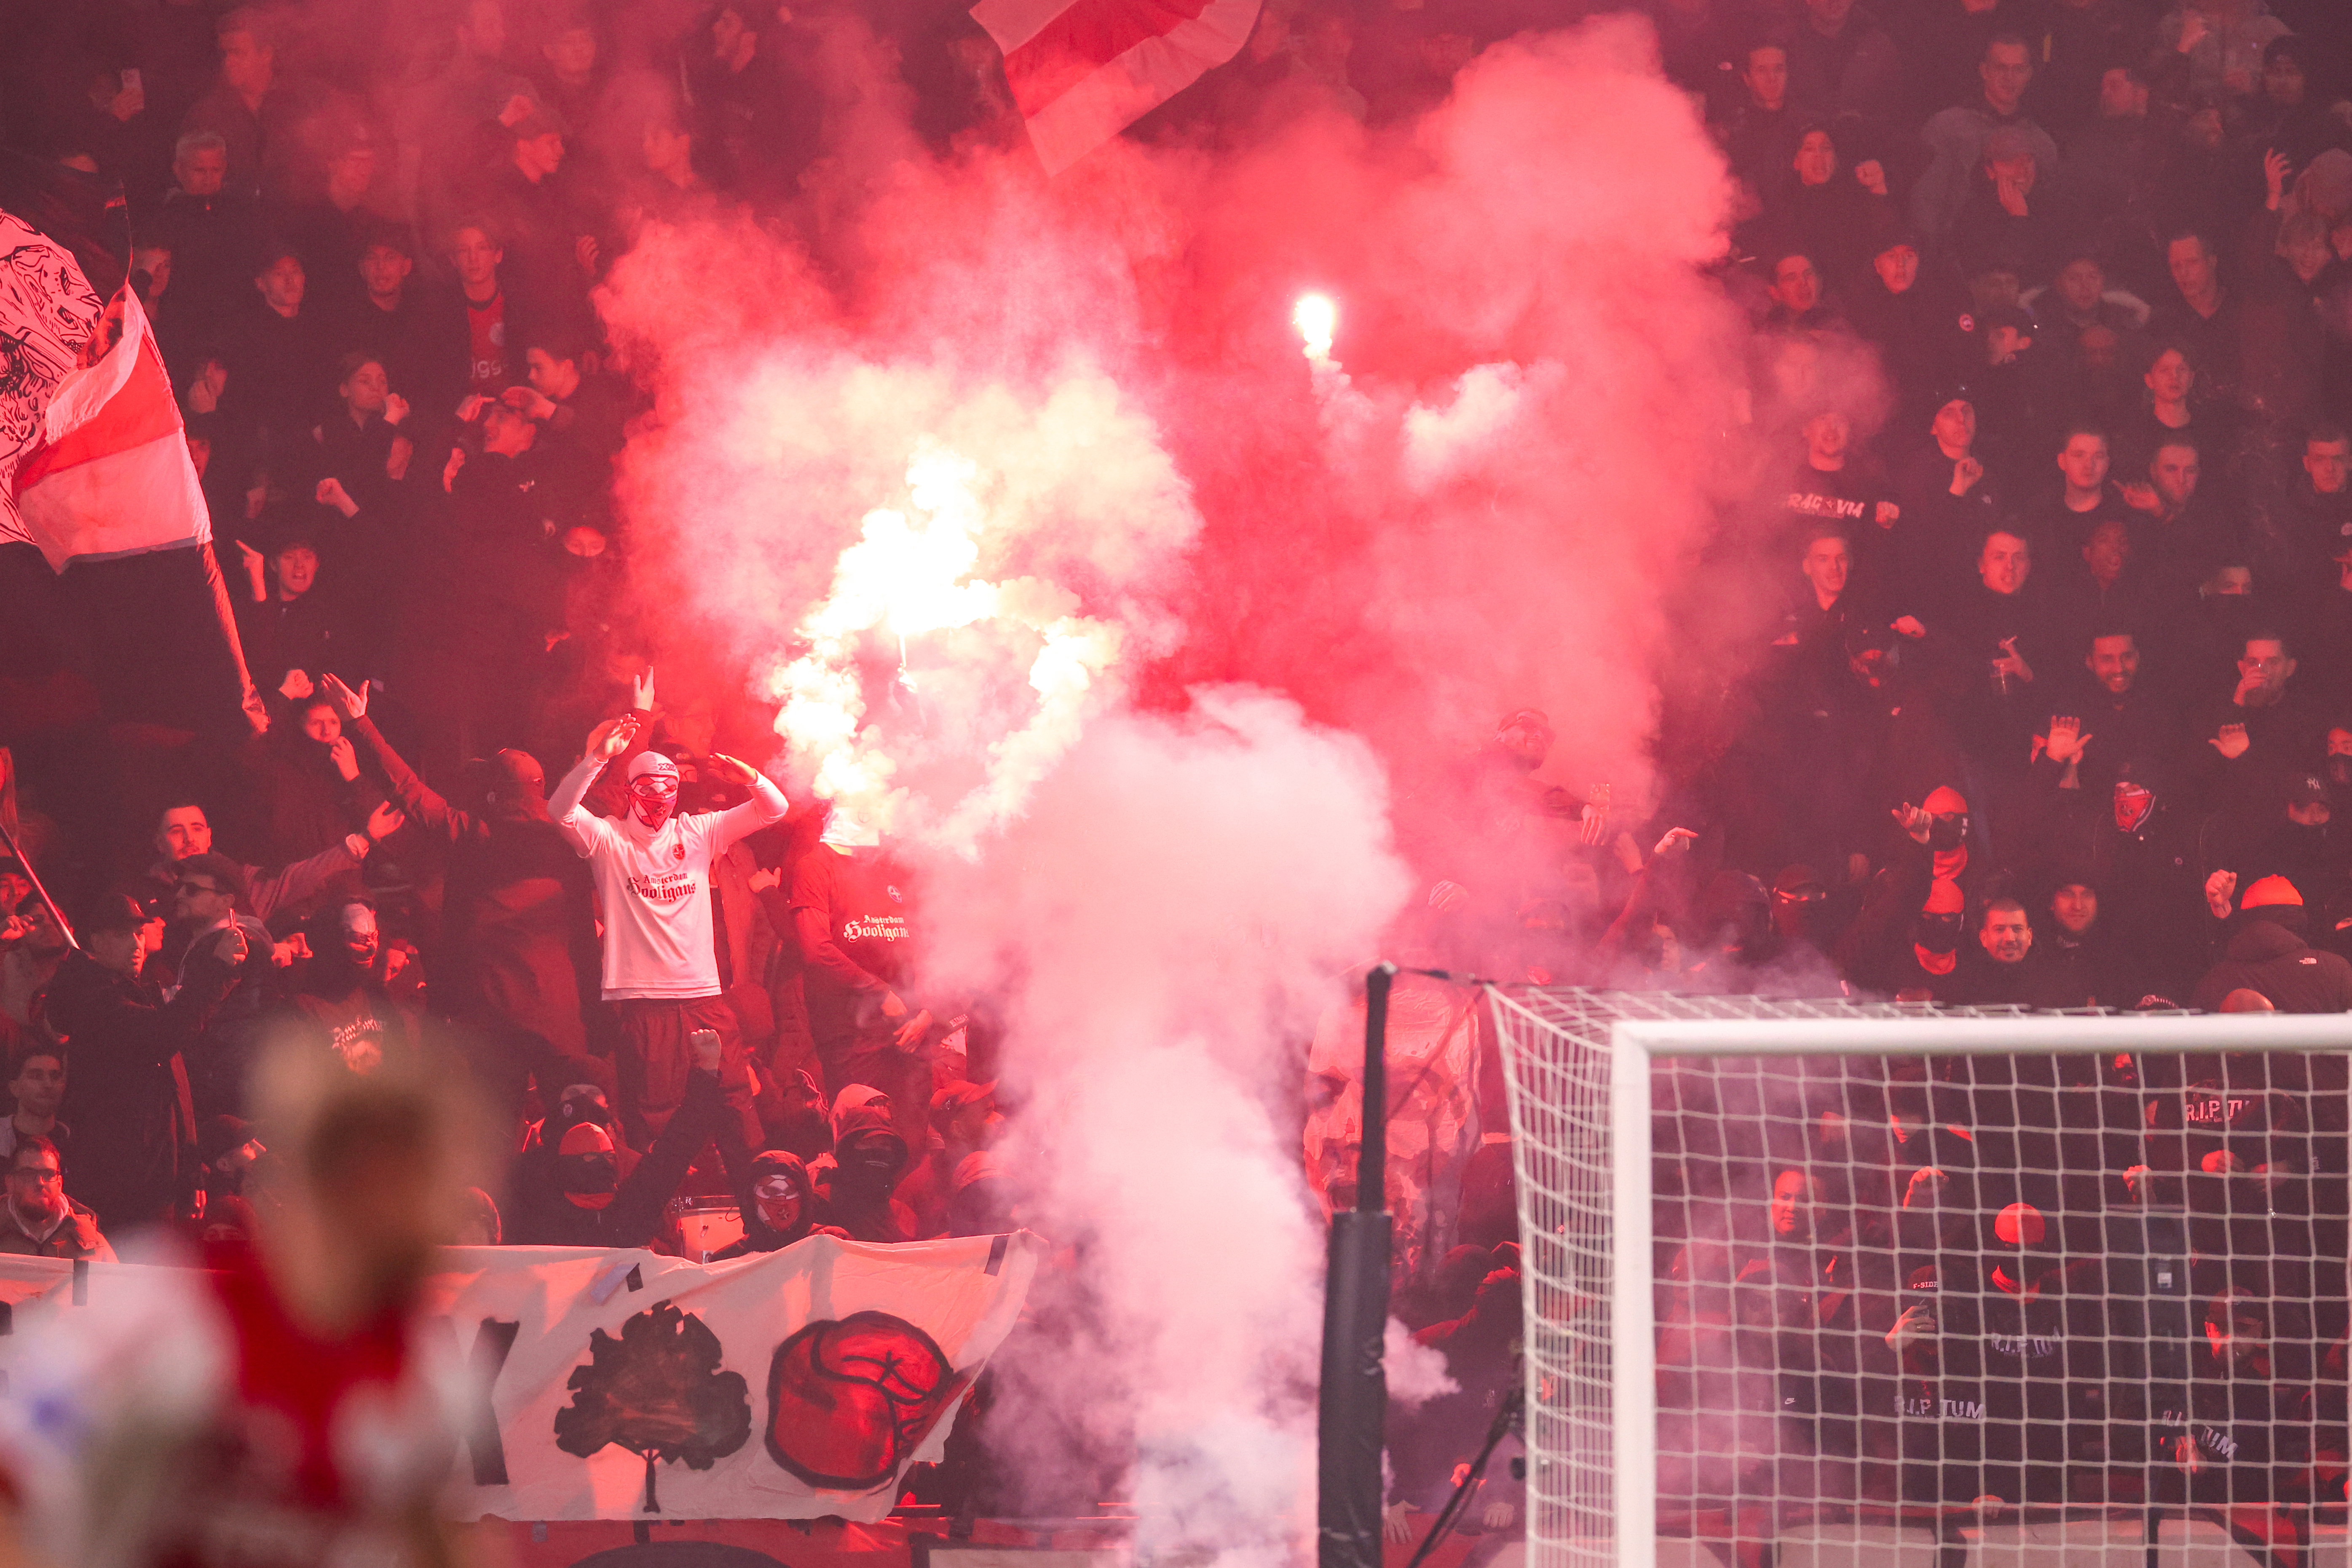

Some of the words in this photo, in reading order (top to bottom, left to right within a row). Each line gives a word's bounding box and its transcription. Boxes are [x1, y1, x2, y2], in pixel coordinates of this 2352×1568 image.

[627, 876, 696, 903] Hooligans
[643, 873, 688, 885] Amsterdam
[1940, 1399, 1986, 1420] TUM
